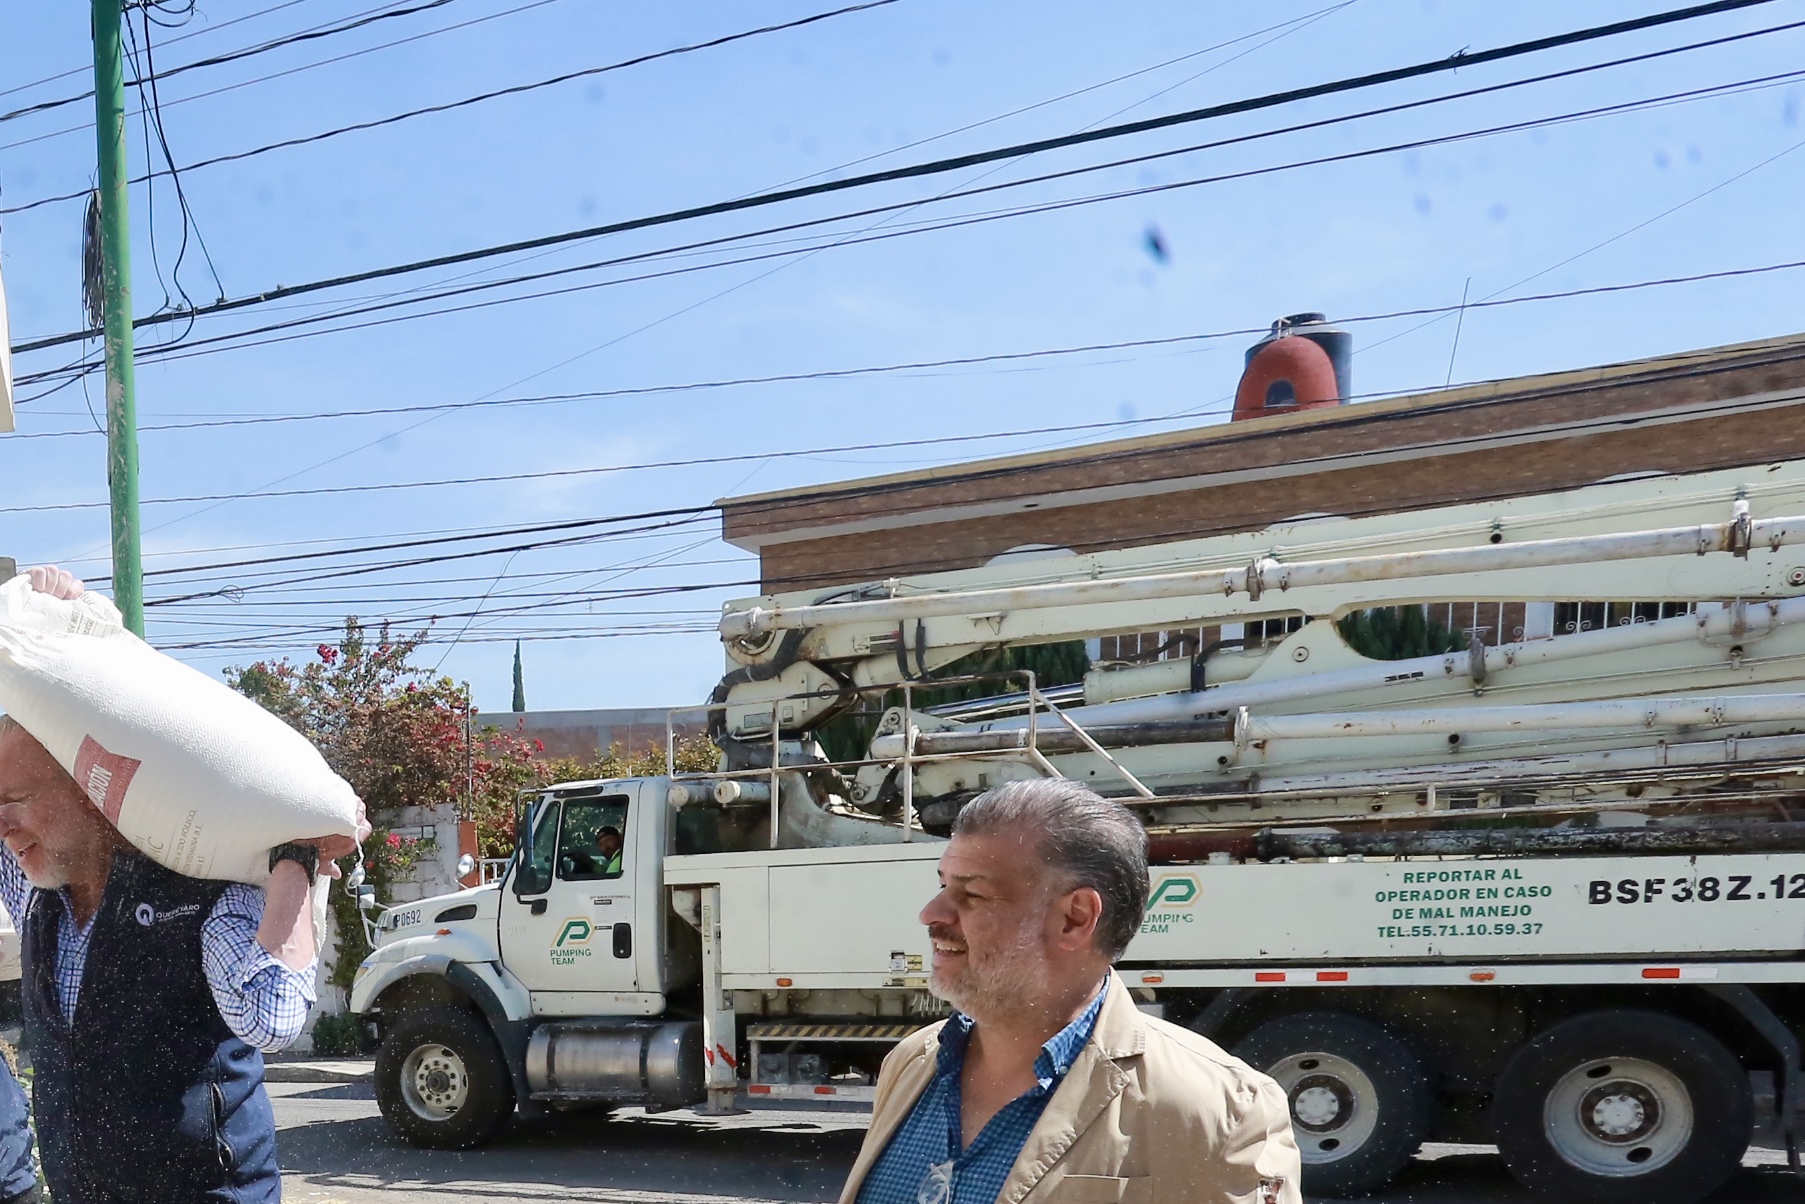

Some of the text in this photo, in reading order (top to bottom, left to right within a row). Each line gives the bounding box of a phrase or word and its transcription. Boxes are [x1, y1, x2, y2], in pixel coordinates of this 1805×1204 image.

[1403, 868, 1523, 884] REPORTAR AL
[1375, 885, 1552, 903] OPERADOR EN CASO
[1392, 905, 1532, 920] DE MAL MANEJO
[1140, 924, 1169, 934] EAM
[1377, 923, 1543, 938] TEL.55.71.10.59.37
[550, 948, 592, 957] PUMPING
[551, 957, 575, 966] TEAM
